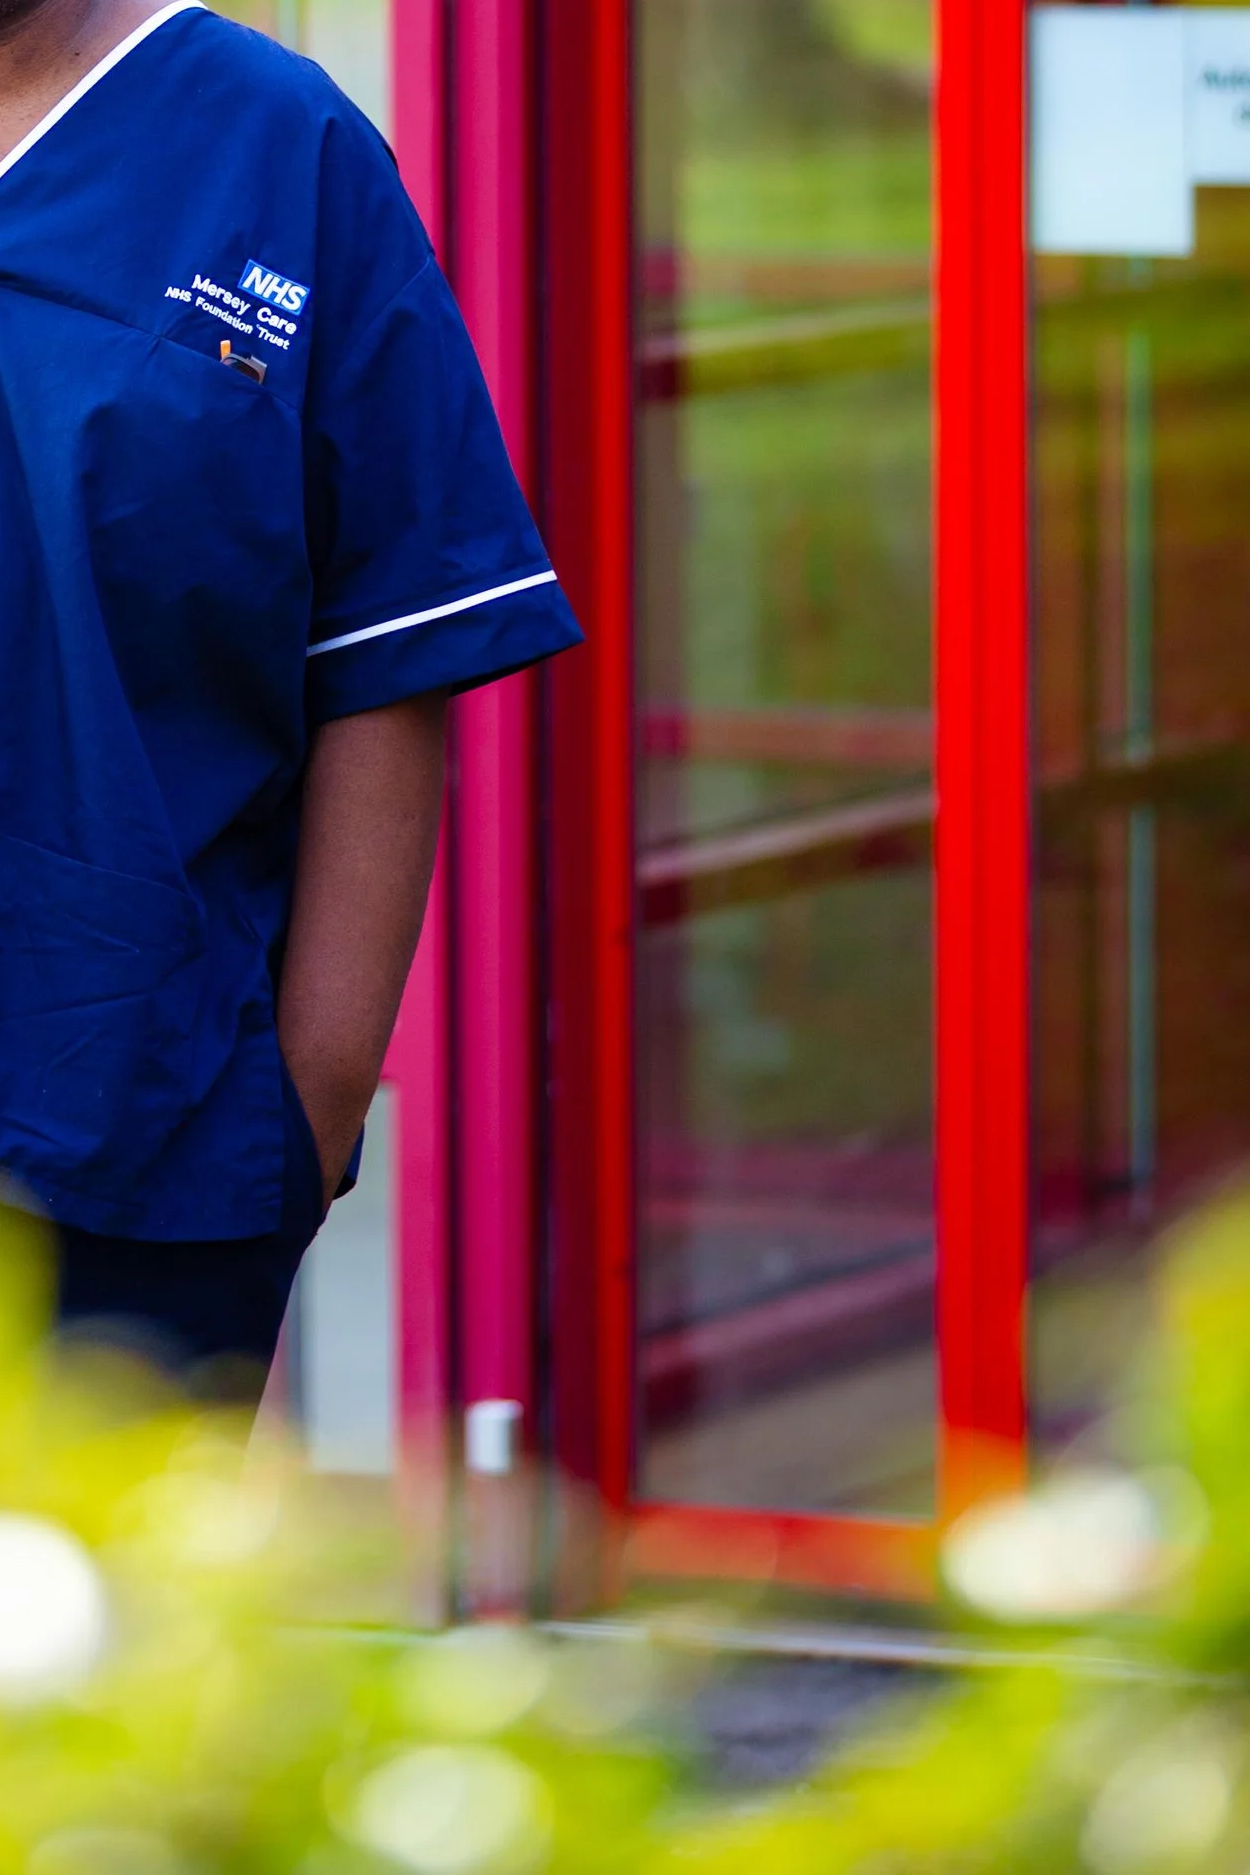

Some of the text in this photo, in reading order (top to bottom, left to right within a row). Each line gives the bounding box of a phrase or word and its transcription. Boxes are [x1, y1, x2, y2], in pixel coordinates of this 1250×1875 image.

[164, 286, 290, 350] NHS Foundation Trust
[192, 274, 297, 335] Mersey Care
[242, 266, 307, 311] NHS
